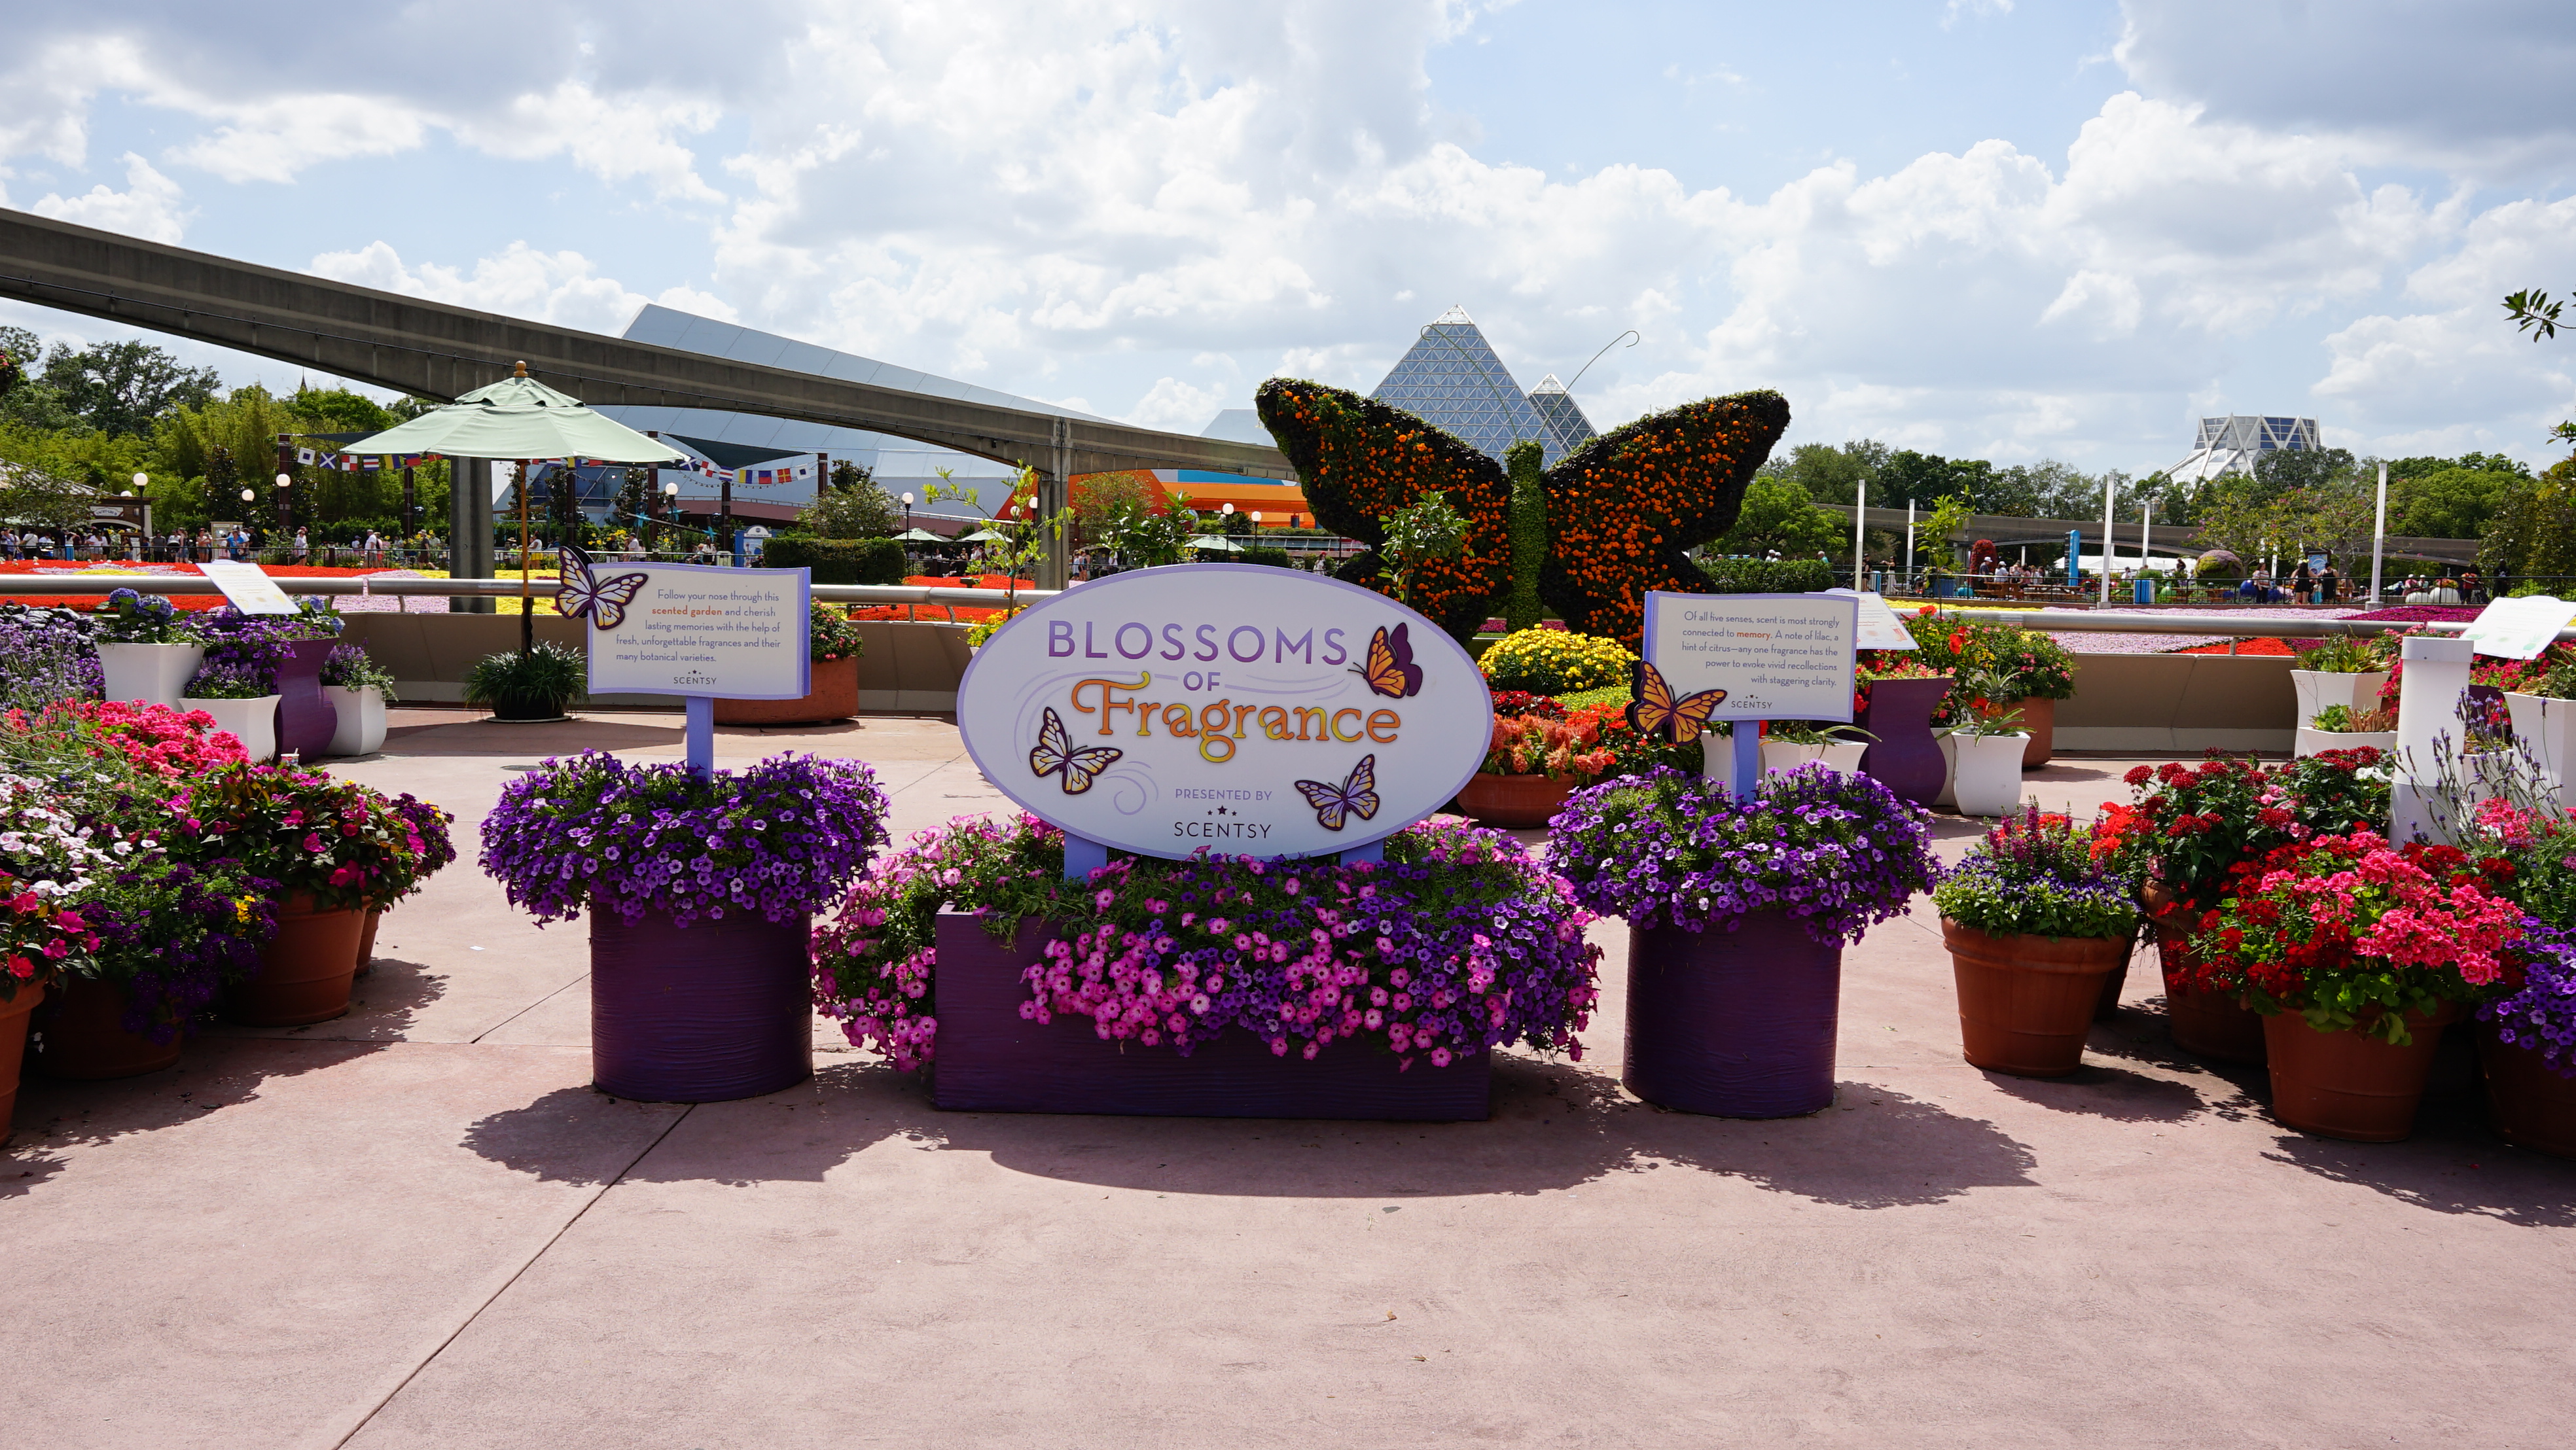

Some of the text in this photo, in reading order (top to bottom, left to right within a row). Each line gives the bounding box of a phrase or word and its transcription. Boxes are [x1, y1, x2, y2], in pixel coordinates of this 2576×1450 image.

[657, 589, 686, 599] Follow
[730, 590, 762, 603] through
[764, 591, 779, 601] this
[652, 605, 776, 618] scented garden and cherish
[1684, 610, 1697, 621] Of
[1699, 611, 1708, 622] all
[1709, 611, 1724, 622] five
[1756, 616, 1778, 624] scent
[1787, 617, 1807, 626] most
[1808, 616, 1840, 629] strongly
[645, 620, 781, 635] lasting memories with the help of
[1682, 627, 1725, 637] connected
[1726, 629, 1735, 638] to
[1736, 629, 1773, 641] memory.
[1775, 629, 1783, 640] A
[1785, 631, 1803, 640] note
[1804, 630, 1814, 641] of
[1814, 630, 1833, 642] lilac,
[616, 634, 781, 649] fresh, unforgettable fragrances and their
[1048, 620, 1347, 665] BLOSSOMS
[1682, 641, 1697, 651] hint
[1698, 641, 1708, 652] of
[1771, 643, 1808, 657] fragrance
[1810, 645, 1823, 656] has
[1825, 645, 1838, 656] the
[616, 650, 717, 663] many botanical varieties.
[1705, 660, 1730, 669] power
[1742, 658, 1766, 669] evoke
[1767, 660, 1786, 669] vivid
[1787, 660, 1838, 671] recollections
[673, 677, 717, 685] SCENTSY
[1183, 671, 1221, 691] OF
[1751, 674, 1837, 688] with staggering clarity.
[1730, 700, 1773, 709] SCENTSY
[1071, 671, 1401, 762] Fragrance
[1175, 788, 1272, 802] PRESENTED BY
[1173, 821, 1272, 839] SCENTSY
